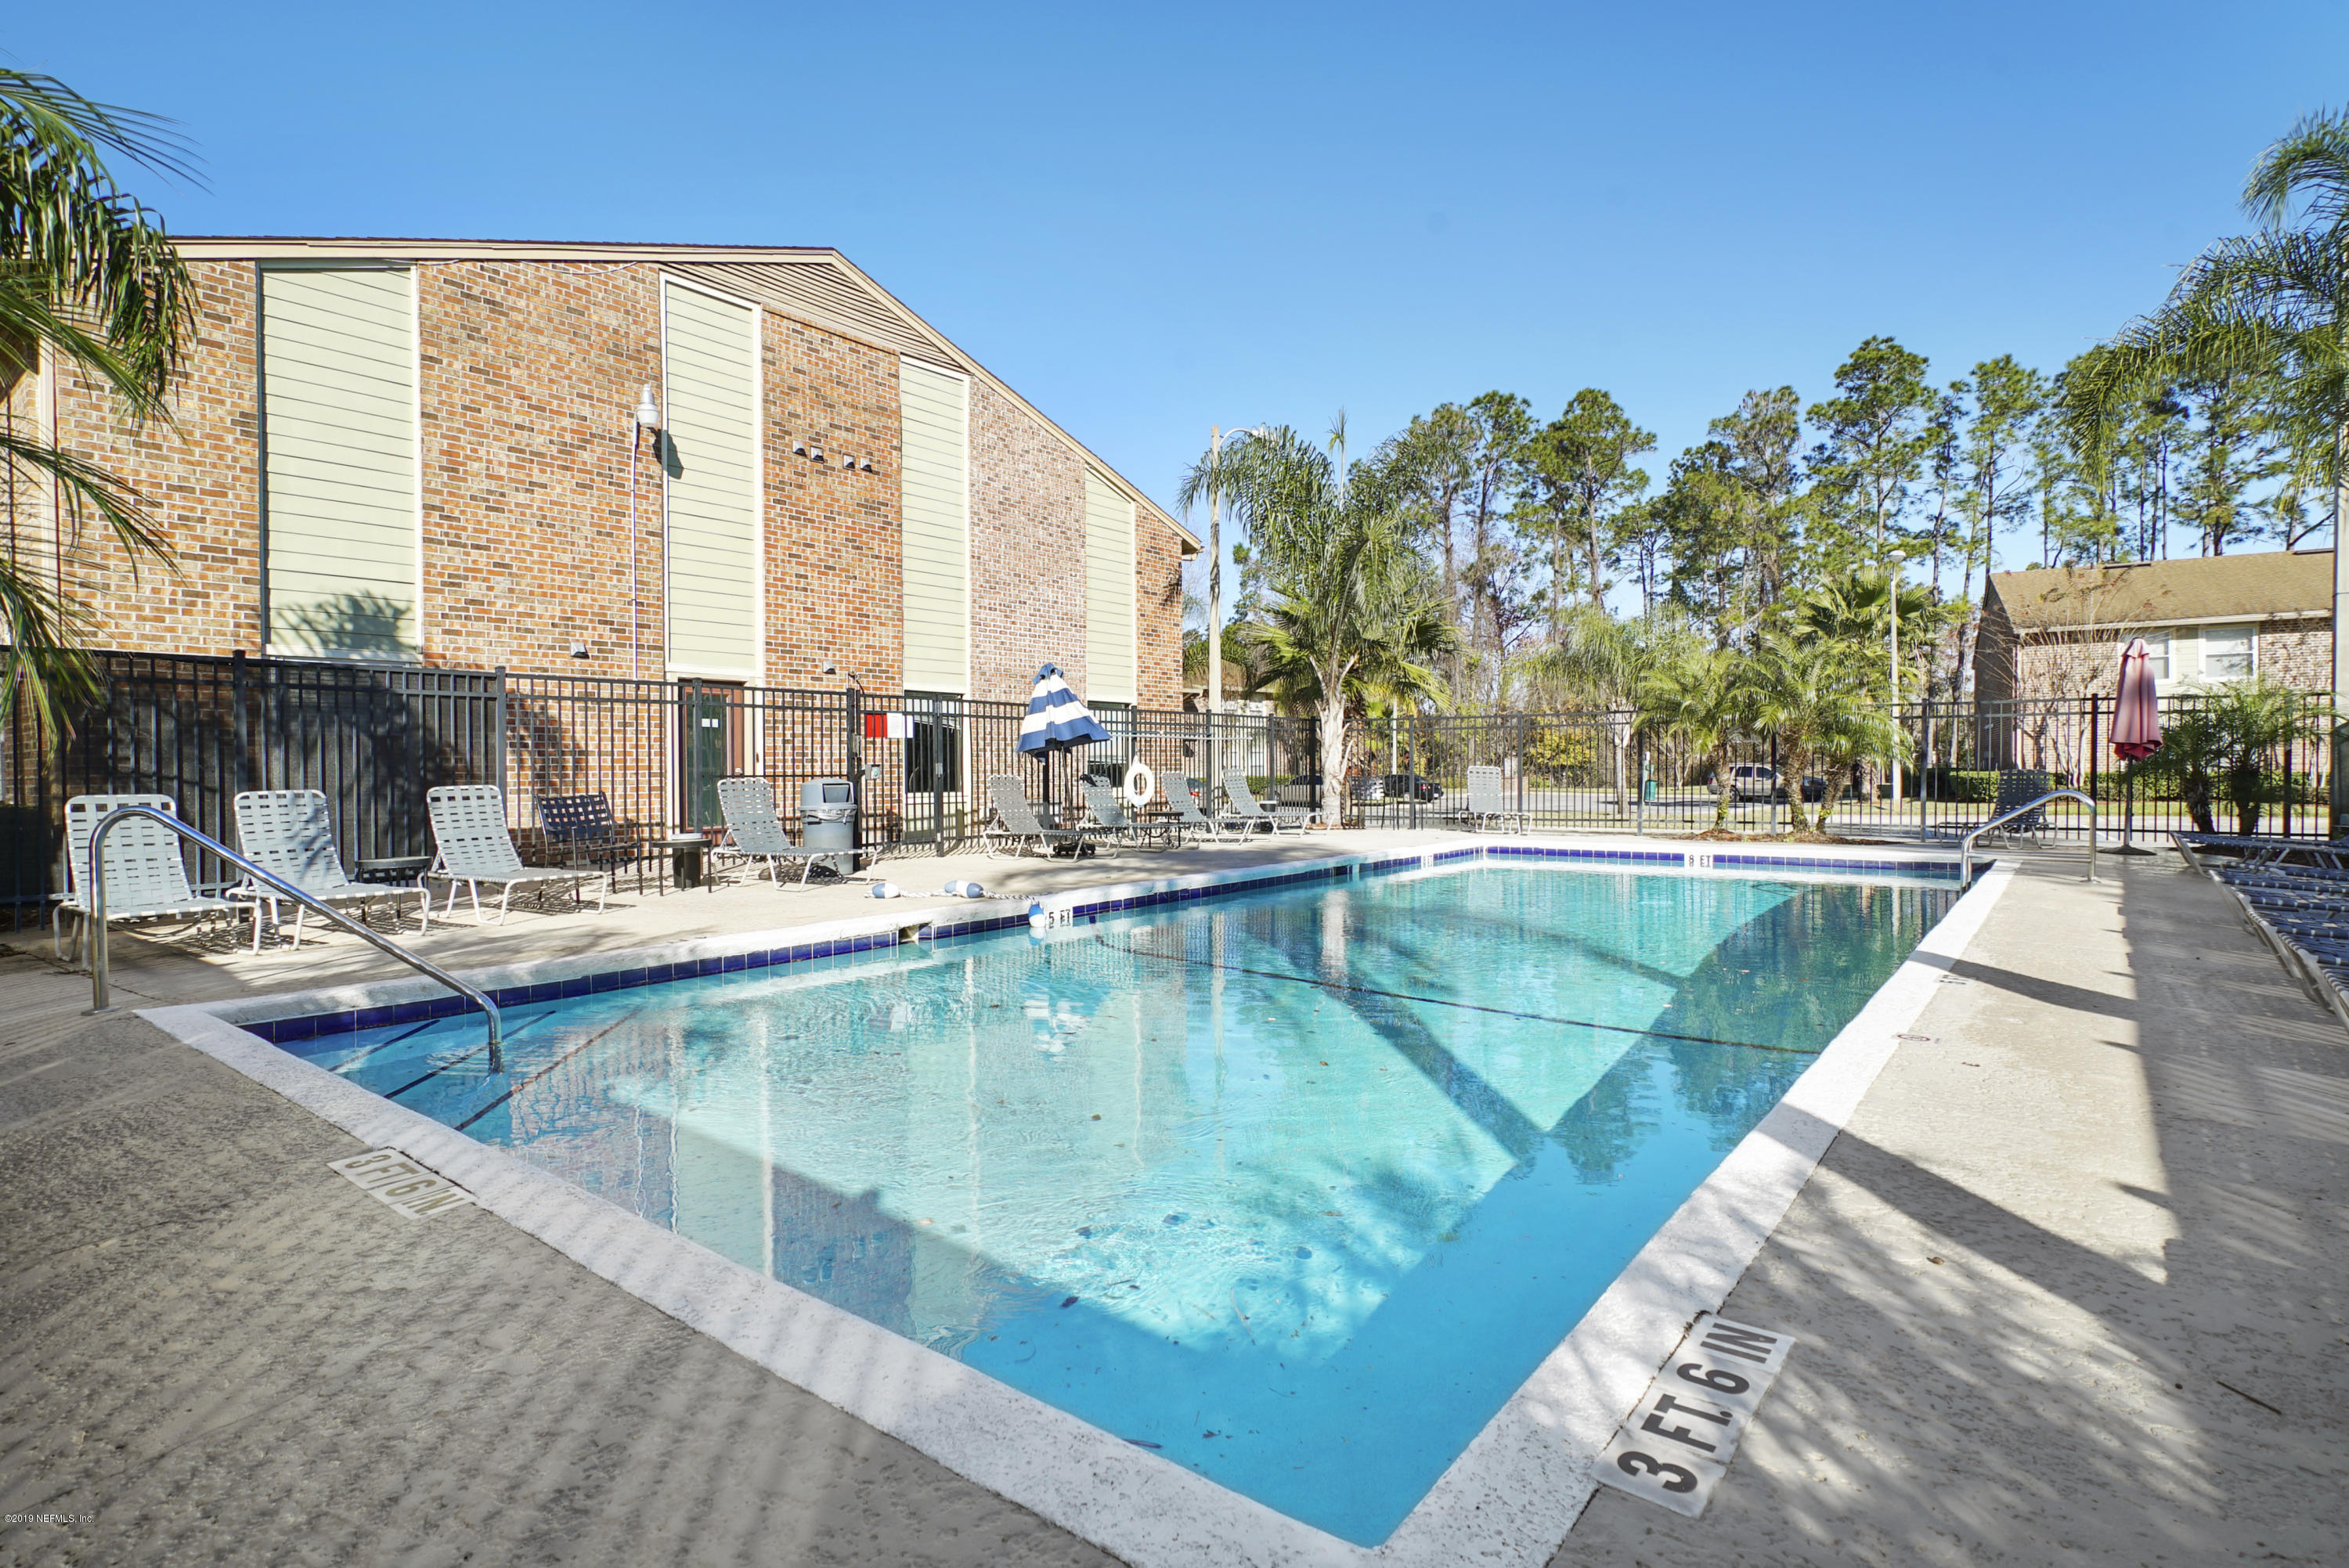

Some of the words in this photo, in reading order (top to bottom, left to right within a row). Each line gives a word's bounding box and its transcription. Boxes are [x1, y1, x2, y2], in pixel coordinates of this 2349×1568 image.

[345, 1154, 392, 1169] 3
[357, 1162, 420, 1184] FT
[385, 1179, 437, 1196] 6
[401, 1189, 465, 1215] IN
[1700, 1322, 1777, 1364] IN
[1676, 1363, 1749, 1394] 6
[1640, 1393, 1733, 1453] FT.
[1617, 1451, 1698, 1494] 3
